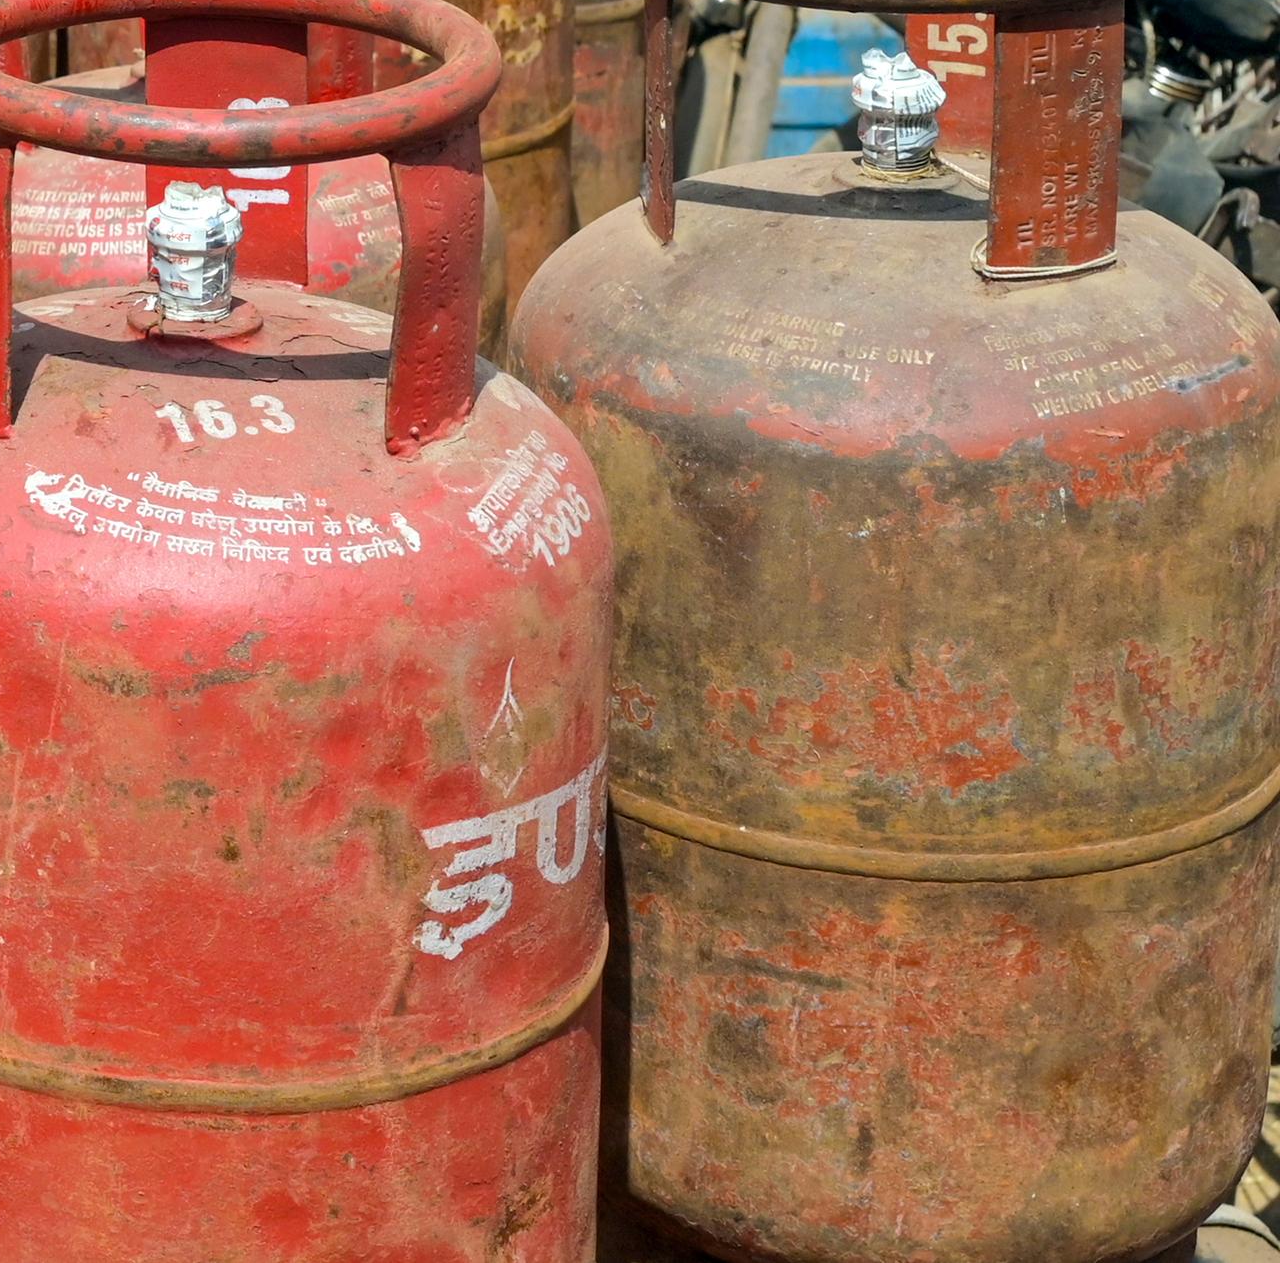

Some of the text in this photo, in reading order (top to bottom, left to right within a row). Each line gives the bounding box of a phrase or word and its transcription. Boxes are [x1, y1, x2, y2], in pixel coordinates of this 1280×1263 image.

[926, 12, 989, 84] 15.
[24, 188, 145, 205] STATUTORY WARNI
[94, 206, 146, 220] DOMES
[78, 224, 106, 239] USE
[108, 223, 123, 237] IS
[125, 221, 146, 236] ST
[57, 241, 88, 257] AND
[886, 347, 938, 367] ONLY
[154, 393, 297, 444] 16.3
[135, 494, 185, 525] केवल
[243, 515, 316, 538] उपयोग
[532, 482, 592, 568] 1906
[165, 532, 216, 558] सख्त
[302, 541, 334, 567] एवं
